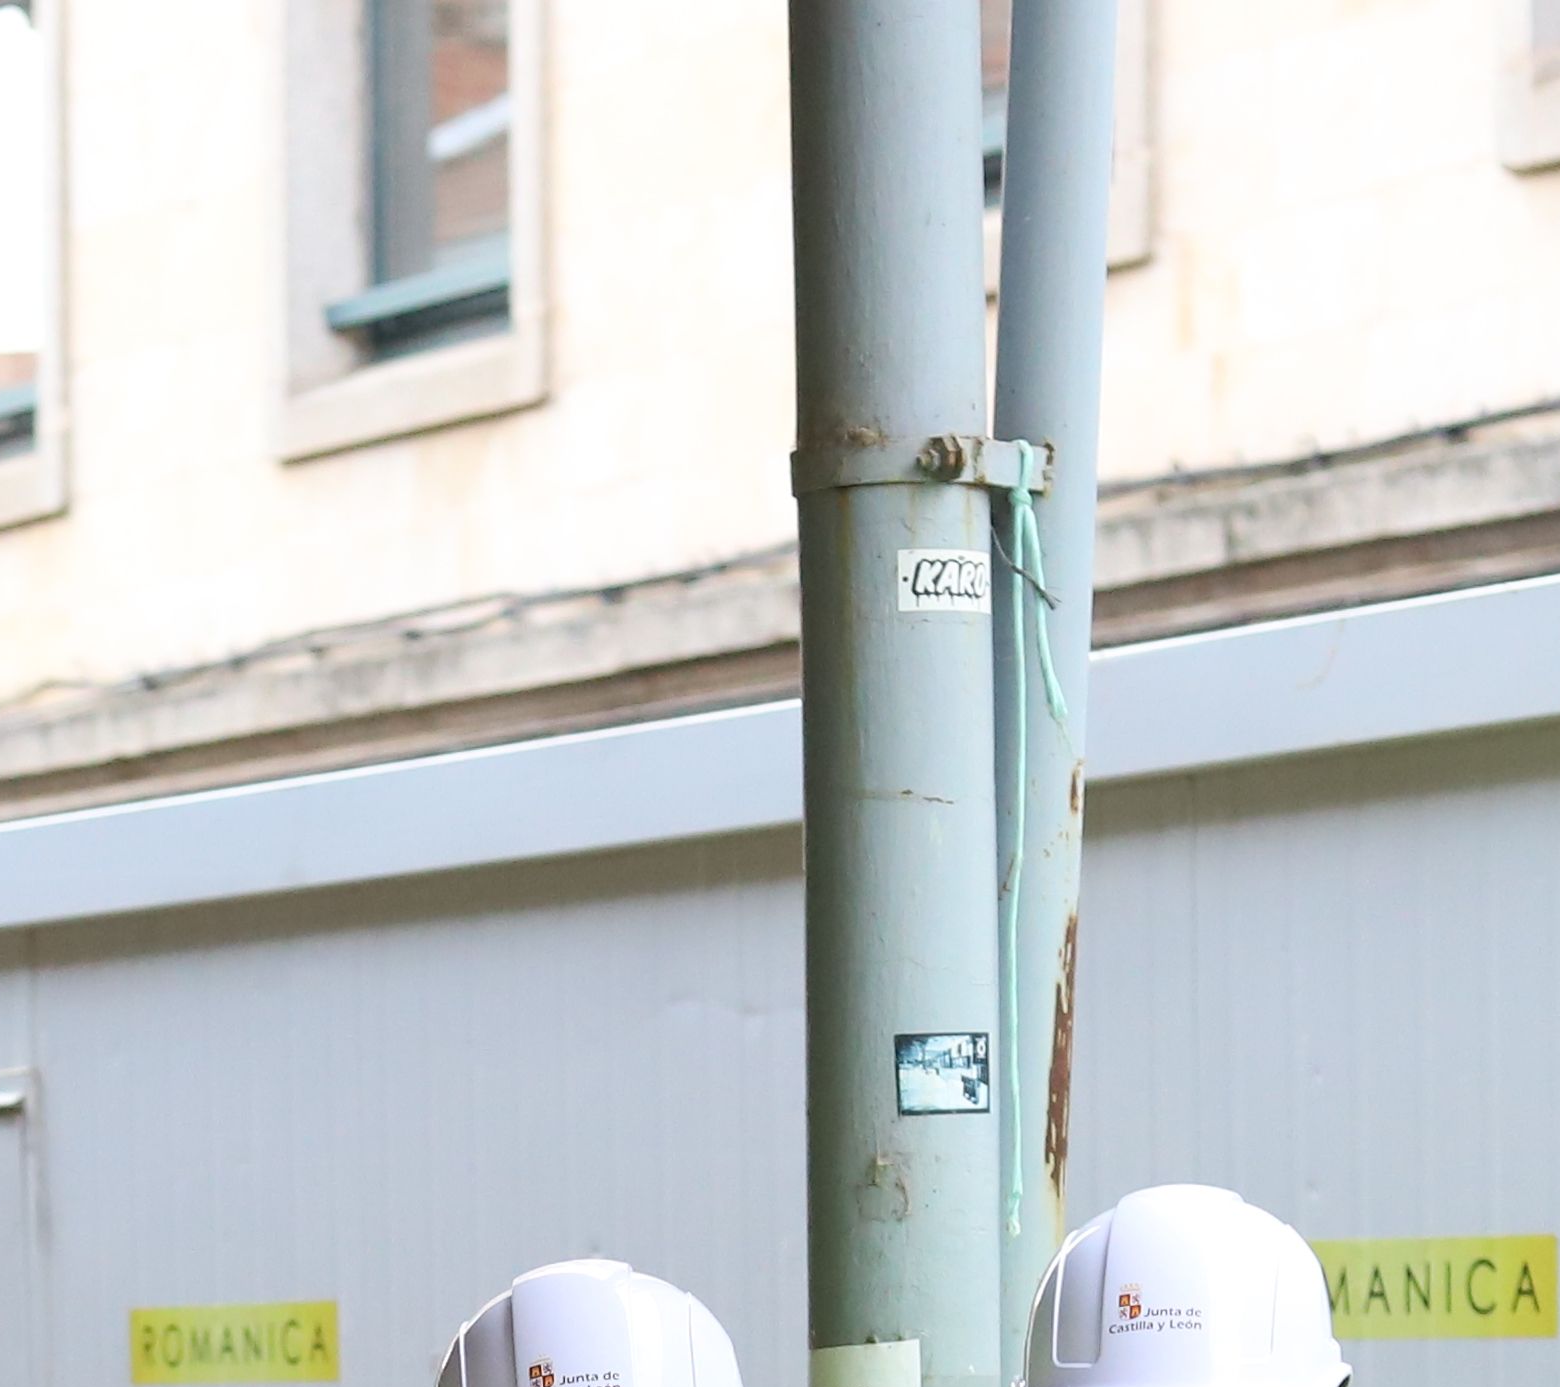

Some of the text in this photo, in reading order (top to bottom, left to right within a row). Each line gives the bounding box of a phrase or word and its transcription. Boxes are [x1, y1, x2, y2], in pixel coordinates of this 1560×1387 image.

[1323, 1259, 1541, 1315] MANICA
[1144, 1307, 1202, 1318] Junta de
[1108, 1319, 1202, 1335] Castilla y León
[142, 1319, 330, 1368] ROMANICA
[559, 1371, 620, 1385] Junta de
